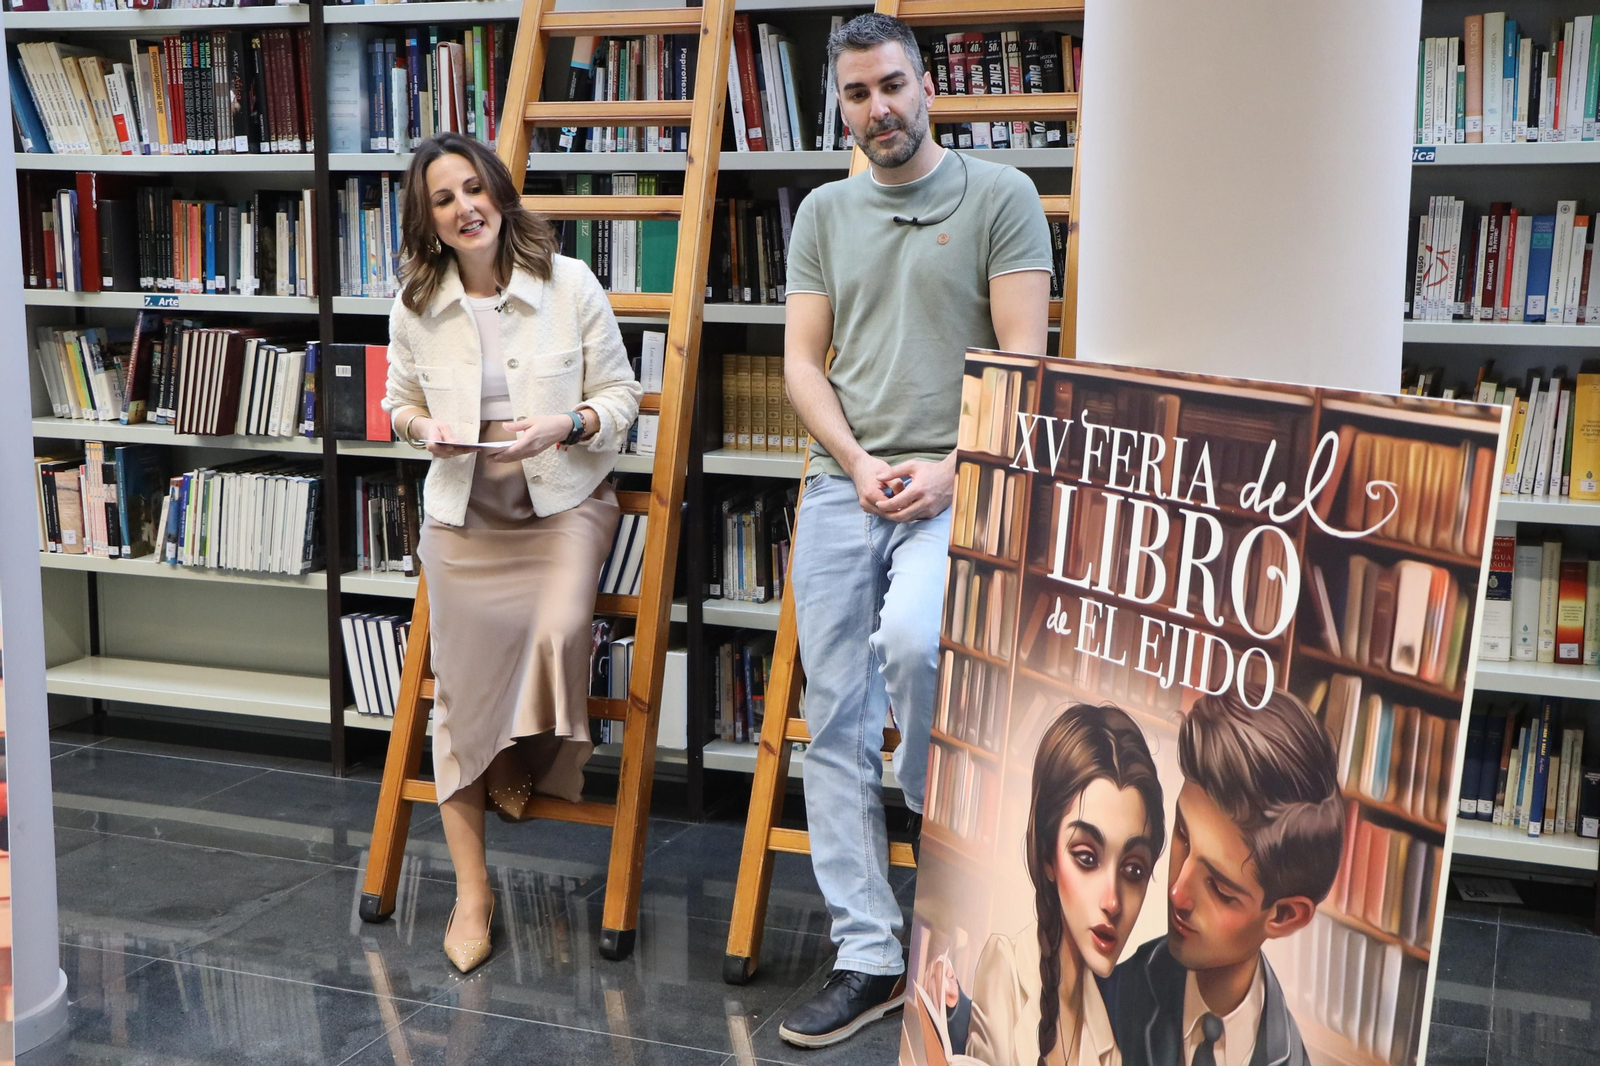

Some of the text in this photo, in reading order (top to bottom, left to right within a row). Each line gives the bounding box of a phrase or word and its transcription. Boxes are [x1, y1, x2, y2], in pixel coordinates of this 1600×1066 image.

[937, 65, 948, 80] CINE
[954, 65, 964, 81] CINE
[971, 65, 983, 86] CINE
[145, 297, 179, 306] 7. Arte
[1009, 411, 1074, 477] XV
[1075, 408, 1220, 512] FERIA
[1239, 430, 1399, 539] del
[1045, 482, 1302, 640] LIBRO
[1046, 597, 1276, 712] de EL EJIDO
